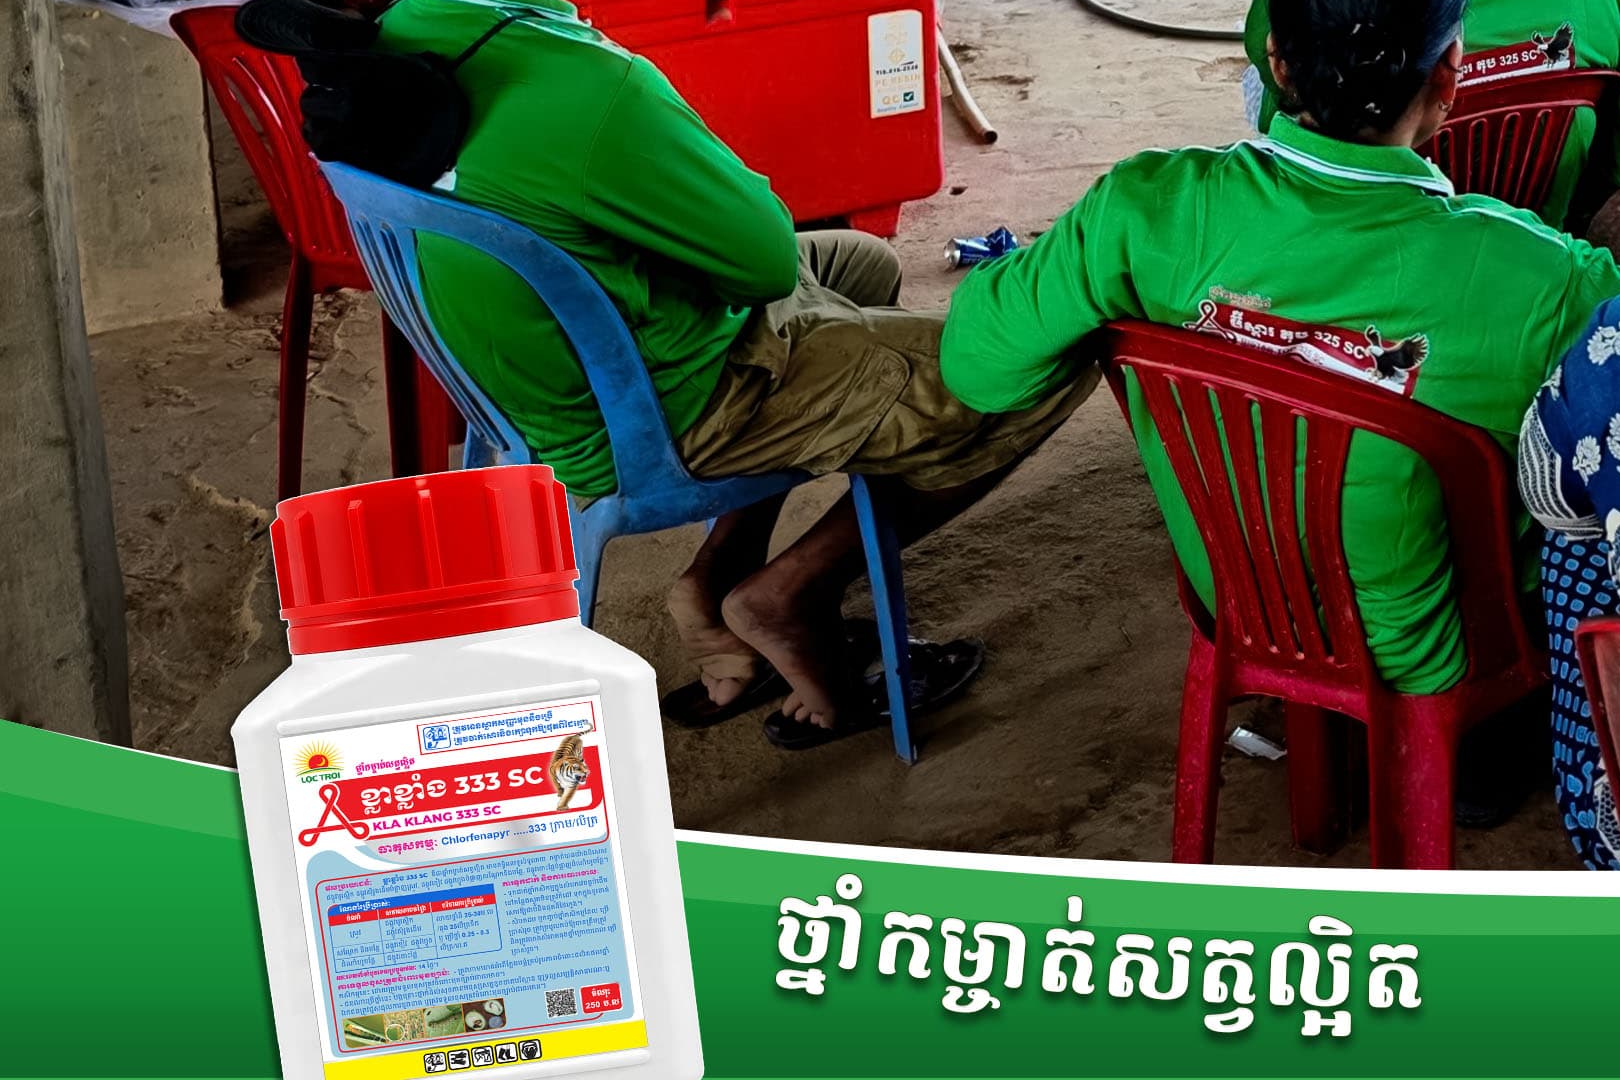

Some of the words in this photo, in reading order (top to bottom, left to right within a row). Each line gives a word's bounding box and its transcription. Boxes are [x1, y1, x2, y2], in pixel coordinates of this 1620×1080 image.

[1499, 53, 1519, 66] 325
[1521, 51, 1537, 62] SC
[1314, 331, 1341, 349] 325
[1343, 340, 1366, 360] SC
[454, 771, 500, 794] 333
[507, 766, 543, 786] SC
[372, 819, 401, 831] KLA
[404, 811, 452, 826] KLANG
[455, 807, 479, 819] 333
[483, 805, 501, 815] SC
[441, 829, 510, 845] Chlorfenapyr
[585, 1000, 600, 1009] 250
